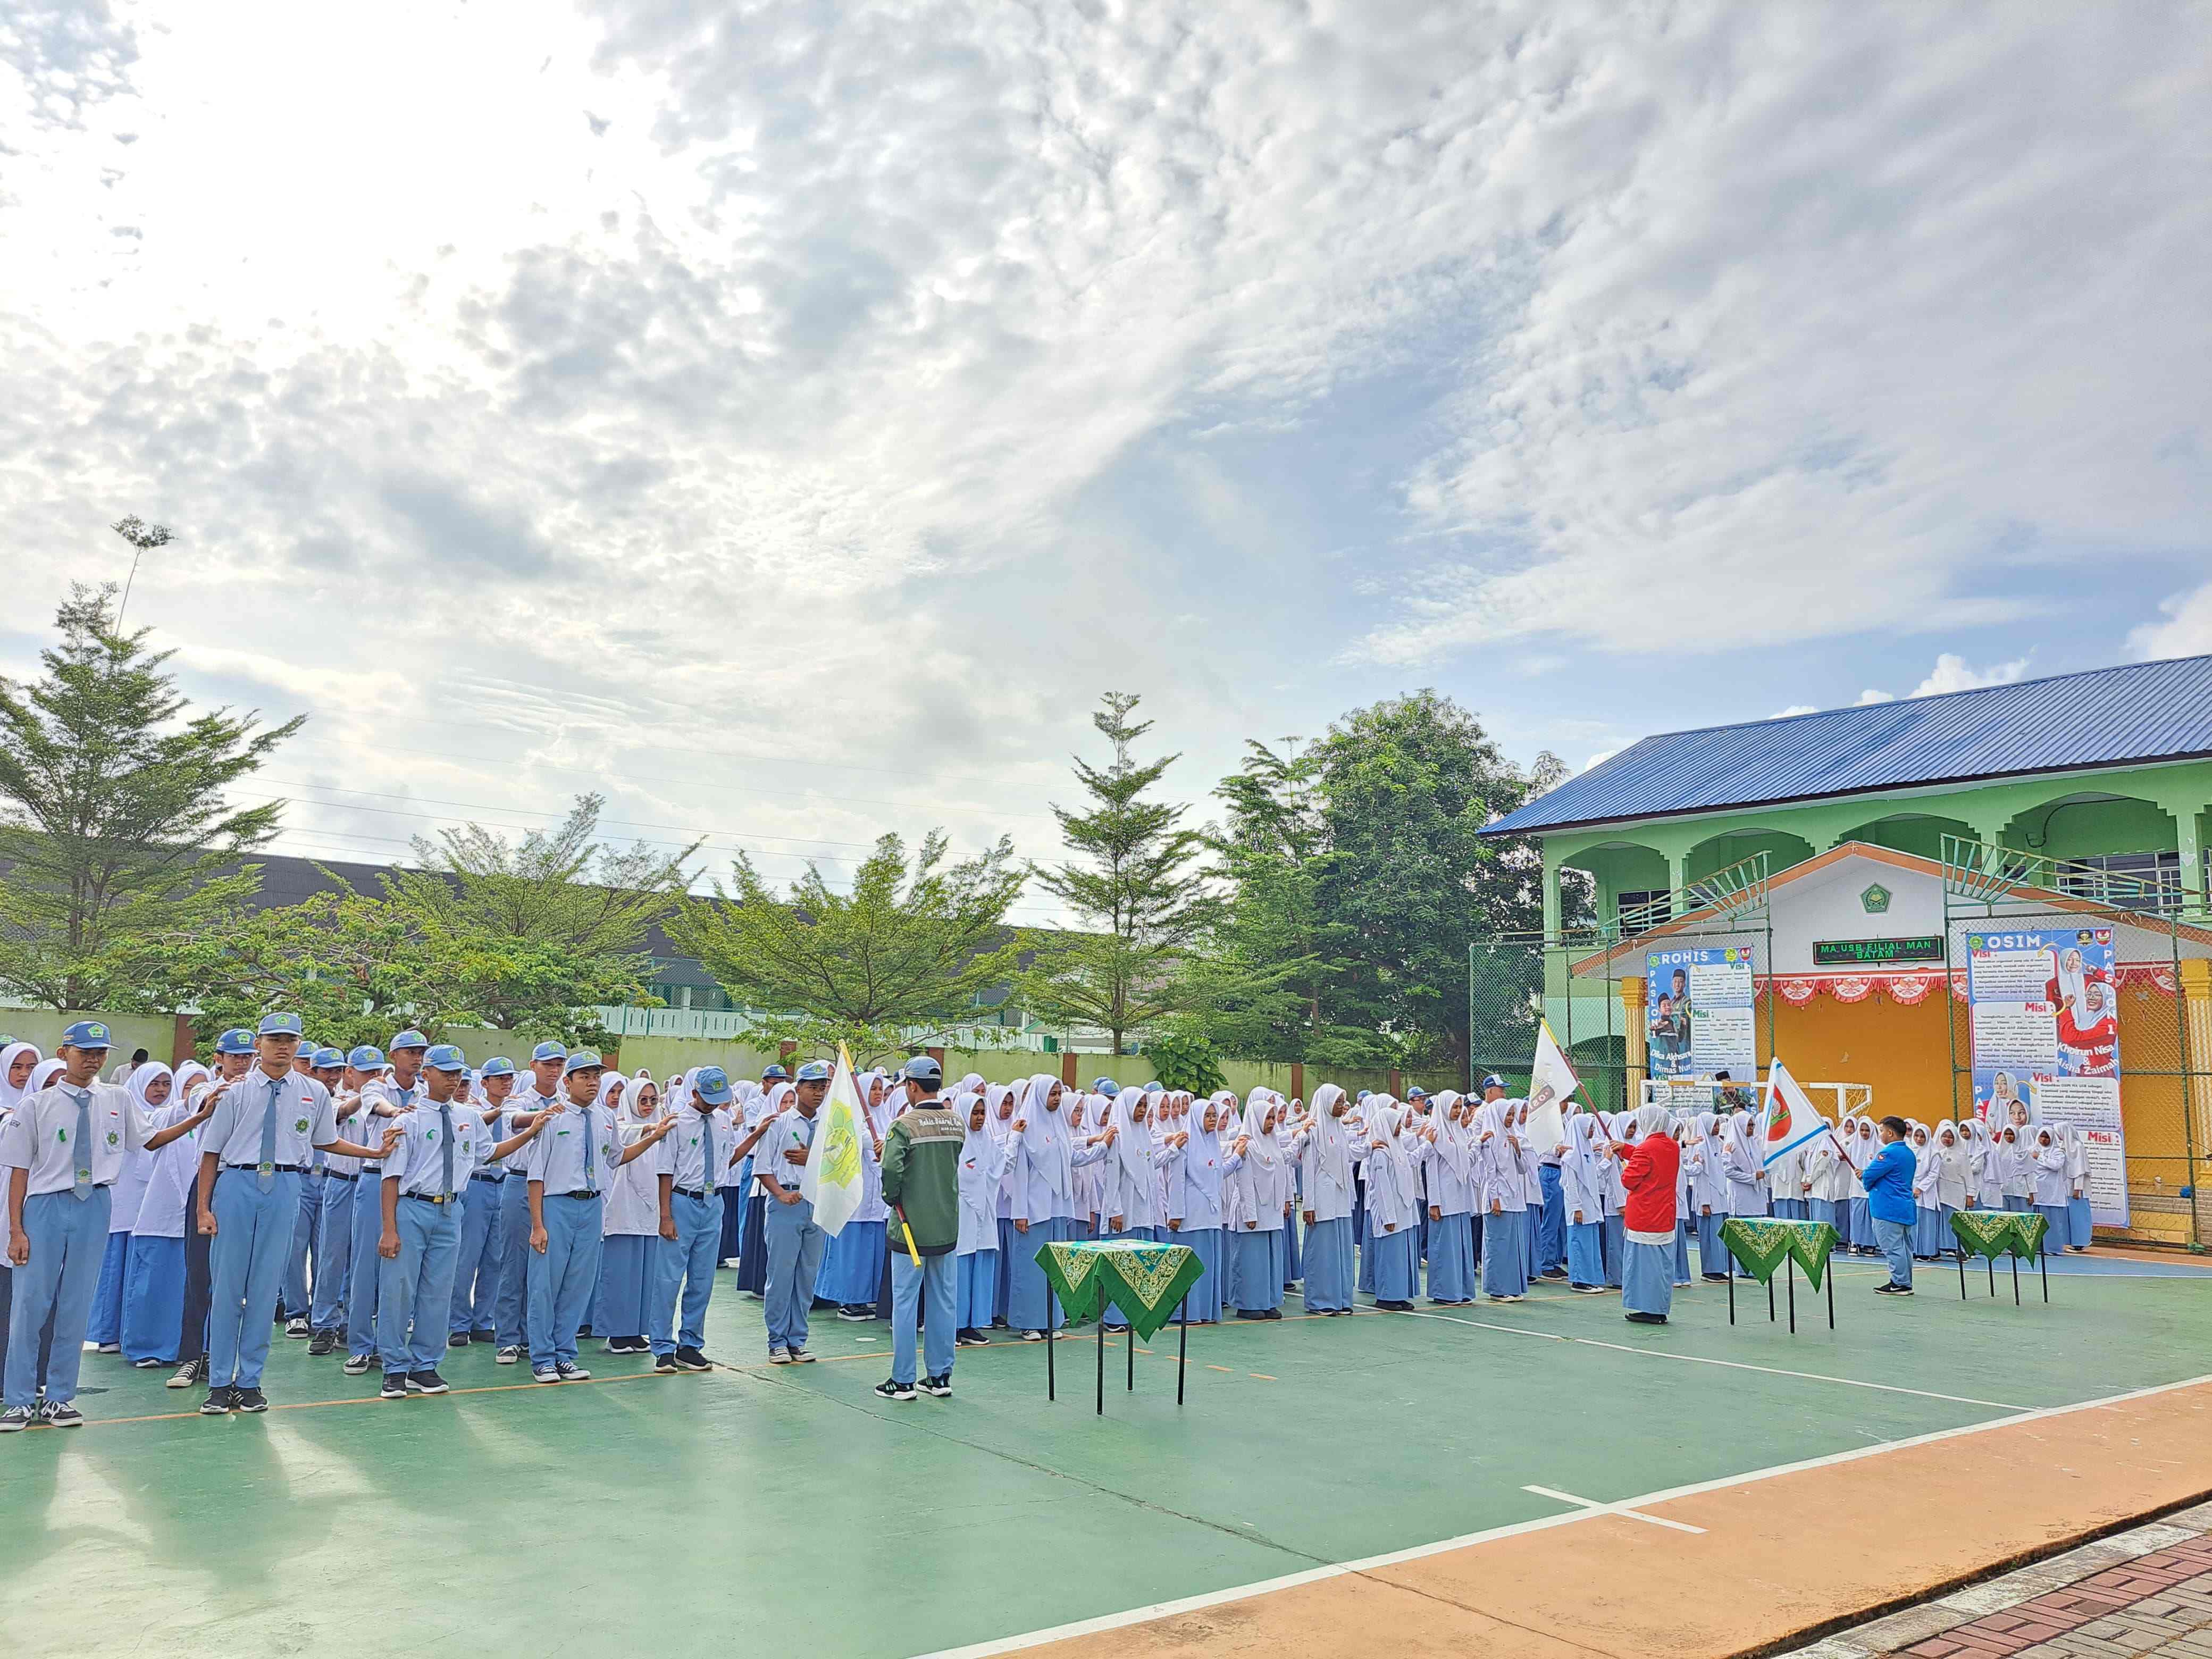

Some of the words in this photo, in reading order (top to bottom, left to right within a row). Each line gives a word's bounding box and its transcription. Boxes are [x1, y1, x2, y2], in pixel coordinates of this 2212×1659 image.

[1820, 945, 1837, 953] MA
[1841, 944, 1862, 952] USB
[1866, 942, 1902, 951] FILIAL
[1906, 941, 1931, 950] MAN
[1987, 935, 2042, 949] OSIM
[1661, 950, 1709, 965] ROHIS
[1856, 950, 1894, 959] BATAM
[1972, 949, 1991, 958] Visi
[1730, 961, 1745, 970] Visi
[2025, 1002, 2047, 1012] Misi
[1693, 1009, 1709, 1018] Misi
[1650, 1049, 1665, 1060] Dika
[2093, 1044, 2115, 1055] Nisa
[1671, 1060, 1677, 1068] &
[2056, 1057, 2081, 1074] Aisha
[2083, 1058, 2119, 1075] Zaimah
[2083, 1057, 2091, 1066] &
[1654, 1063, 1677, 1074] Dimas
[2032, 1071, 2052, 1083] Visi
[2088, 1131, 2112, 1143] Misi
